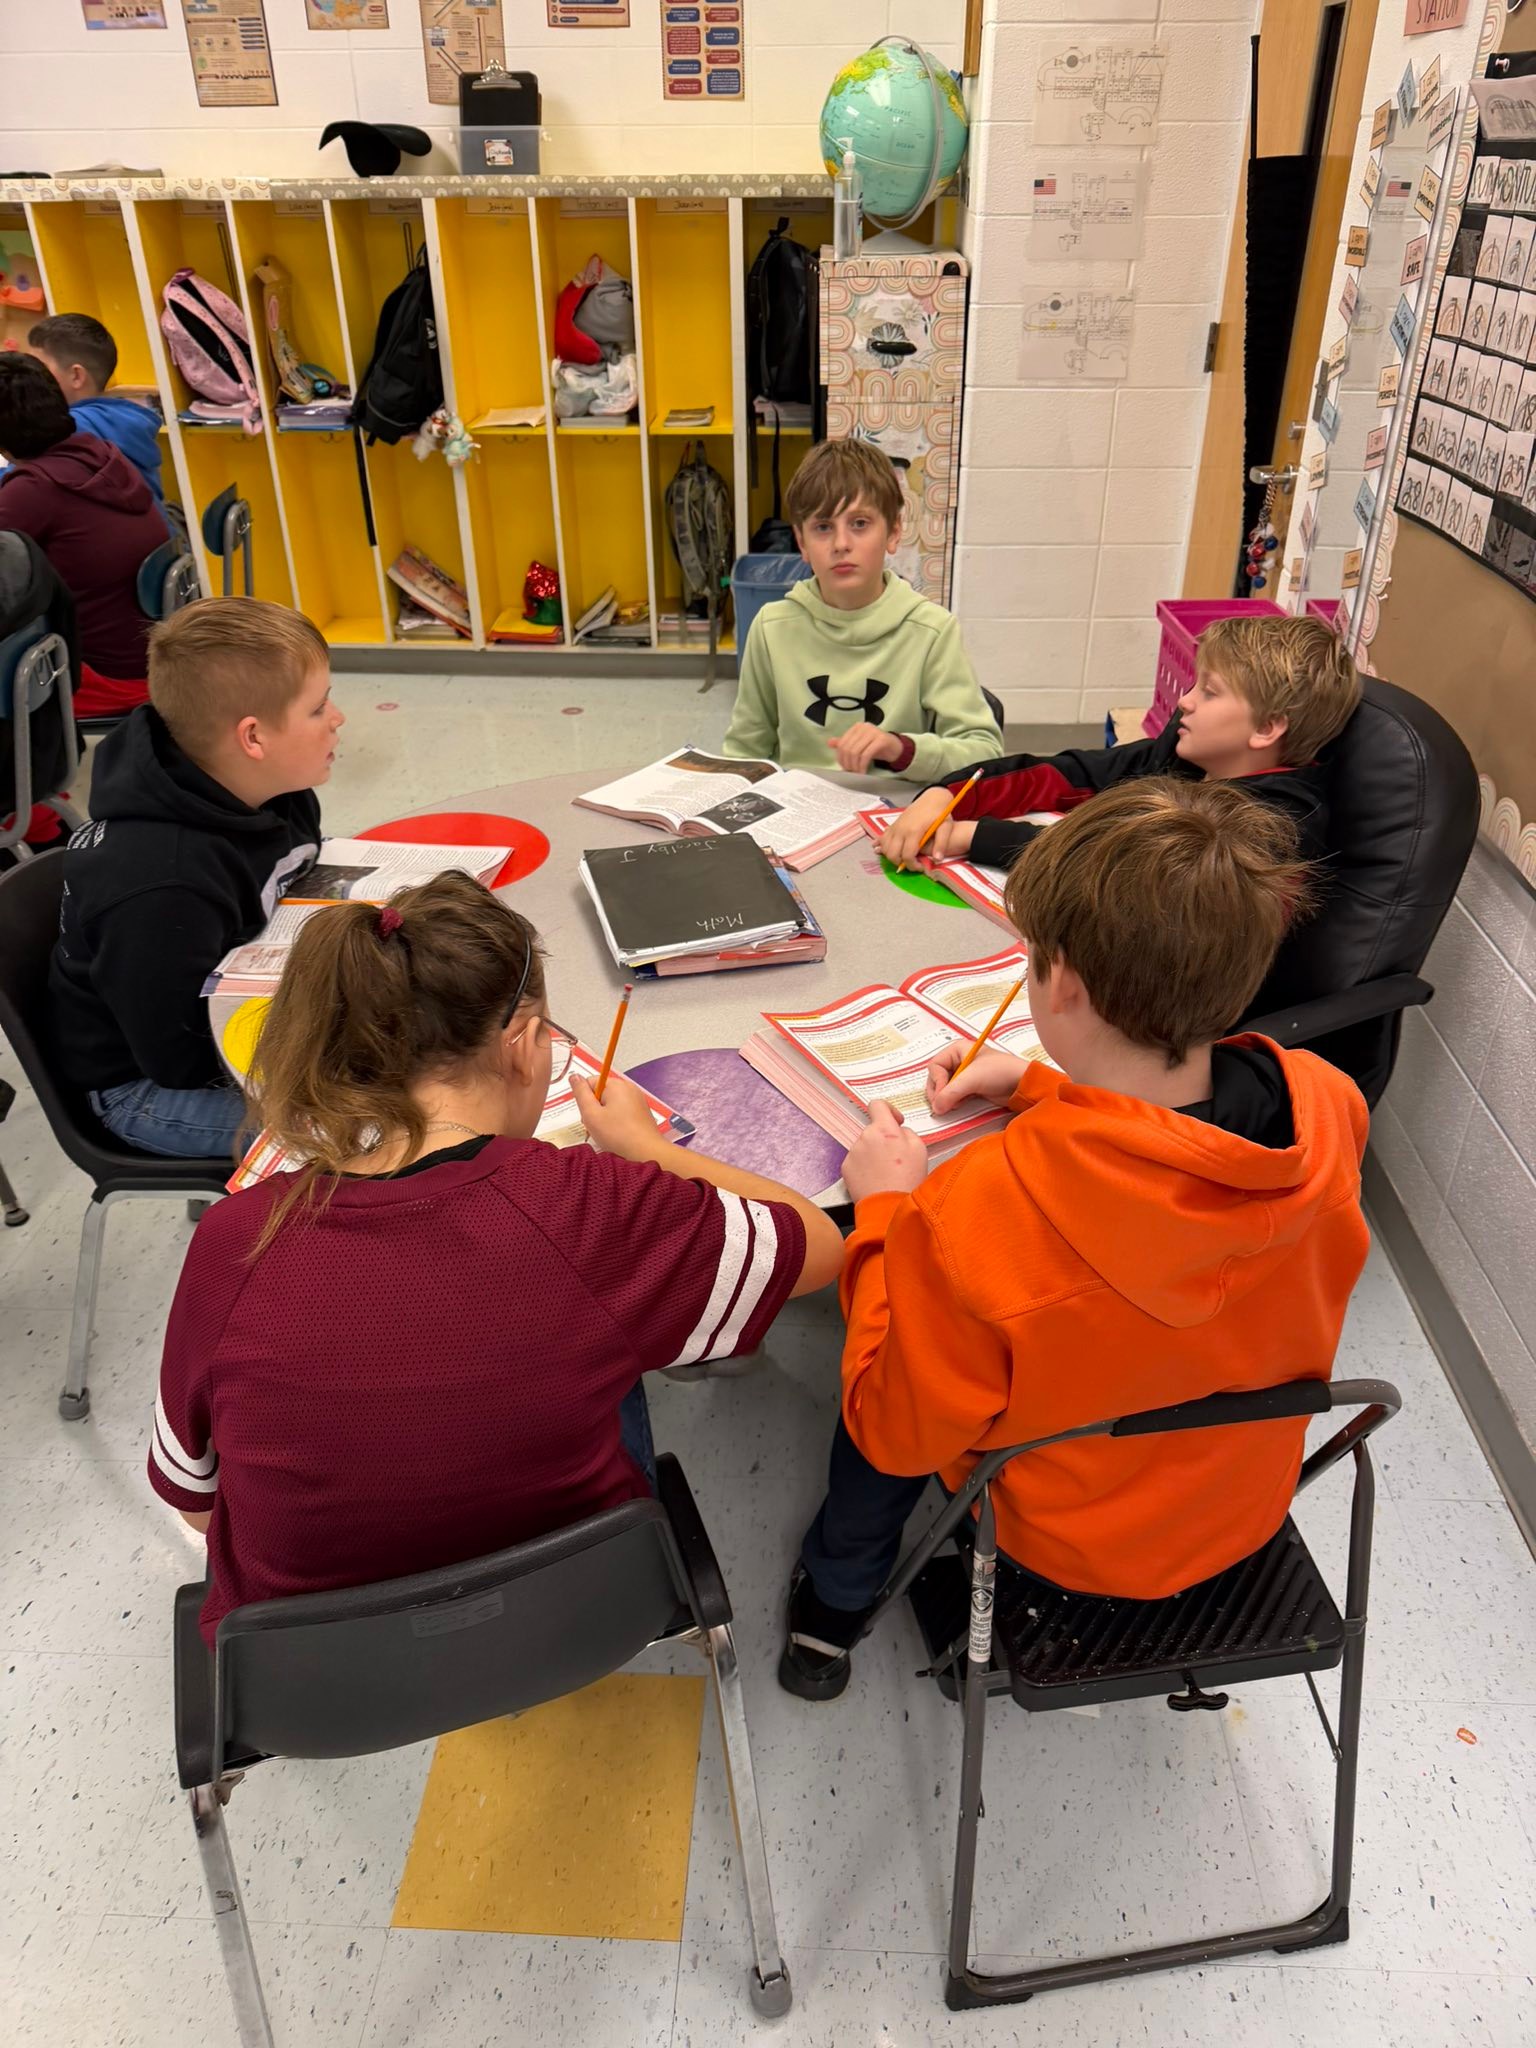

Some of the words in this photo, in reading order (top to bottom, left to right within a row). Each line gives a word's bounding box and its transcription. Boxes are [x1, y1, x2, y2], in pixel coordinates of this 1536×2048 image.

[1406, 260, 1421, 278] SAFE
[1488, 238, 1497, 273] 1
[1509, 239, 1522, 275] 2
[1450, 297, 1458, 331] 7
[1472, 304, 1484, 338] 8
[1497, 311, 1507, 346] 9
[1514, 313, 1529, 350] 10
[1430, 358, 1445, 393] 14
[1455, 367, 1468, 399] 15
[1478, 376, 1491, 411] 16
[1499, 384, 1513, 420] 17
[1521, 393, 1536, 431] 18
[1417, 417, 1434, 452] 21
[1437, 427, 1457, 463] 22
[1459, 437, 1476, 474] 23
[1479, 446, 1500, 484] 24
[1502, 453, 1525, 491] 25
[1401, 476, 1422, 512] 28
[1424, 486, 1444, 520] 29
[1447, 498, 1463, 533] 30
[1468, 512, 1482, 549] 31
[619, 849, 637, 863] J
[696, 912, 744, 931] Math
